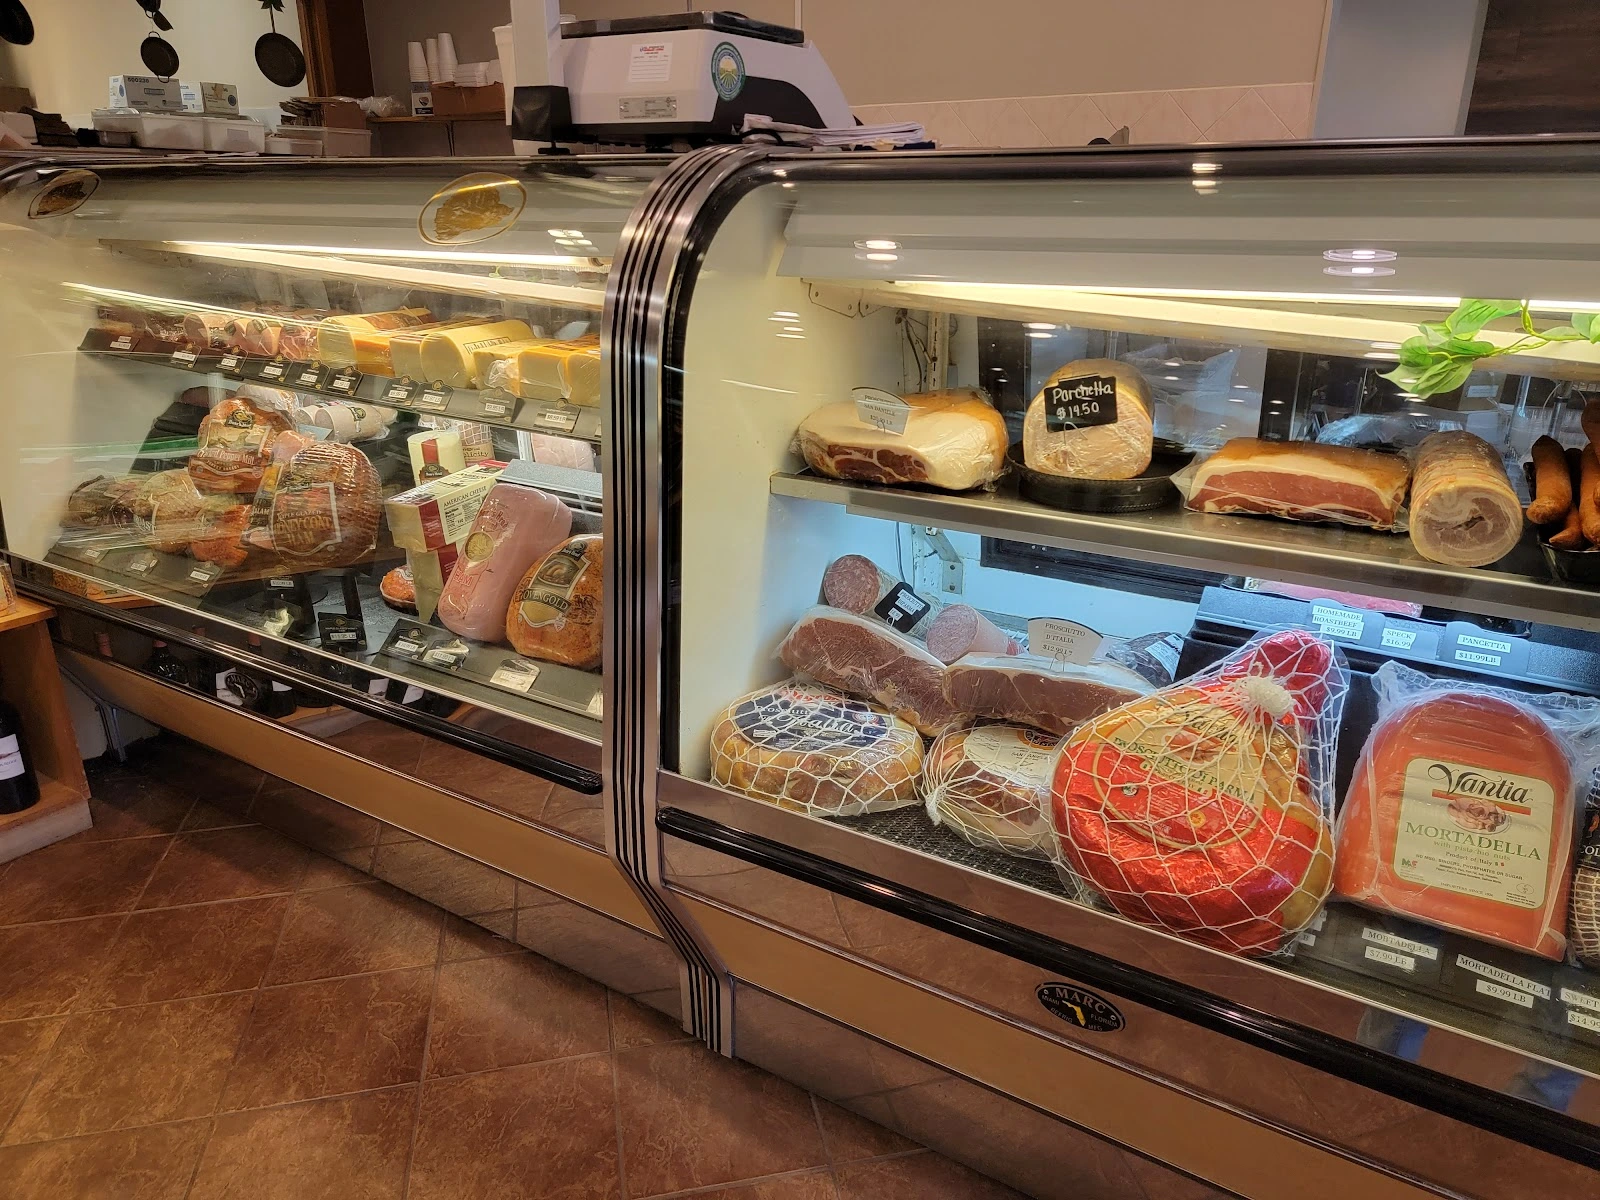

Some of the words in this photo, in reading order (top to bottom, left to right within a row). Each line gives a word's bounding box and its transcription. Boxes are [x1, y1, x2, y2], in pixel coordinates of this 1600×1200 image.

[1052, 381, 1114, 404] Porchetta
[1056, 402, 1100, 420] $14.50
[443, 493, 469, 507] AMERICAN
[523, 589, 569, 611] OVENGOLD
[1314, 615, 1358, 628] ROASTBEEF
[1317, 607, 1361, 620] HOMEMADE
[1044, 622, 1086, 637] PROSCIUTTO
[1326, 626, 1346, 635] $9.99
[1387, 630, 1412, 639] SPECK
[1045, 633, 1074, 644] D'ITALIA
[1386, 638, 1411, 648] $16.99
[1462, 636, 1506, 650] PANCETTA
[1428, 764, 1533, 804] Vantia
[1405, 822, 1541, 861] MORTADELLA
[1434, 840, 1452, 849] with
[1493, 852, 1511, 861] nuts
[1445, 851, 1469, 861] Product
[1479, 858, 1493, 867] Italy
[1370, 949, 1393, 962] $7.99
[1393, 956, 1407, 965] LB
[1460, 957, 1524, 987] MORTADELLA
[1055, 987, 1106, 1014] MARC
[1486, 984, 1511, 998] $9.99
[1512, 995, 1526, 1003] LB
[1041, 994, 1060, 1006] MIAMI
[1090, 1013, 1118, 1028] FLORIDA
